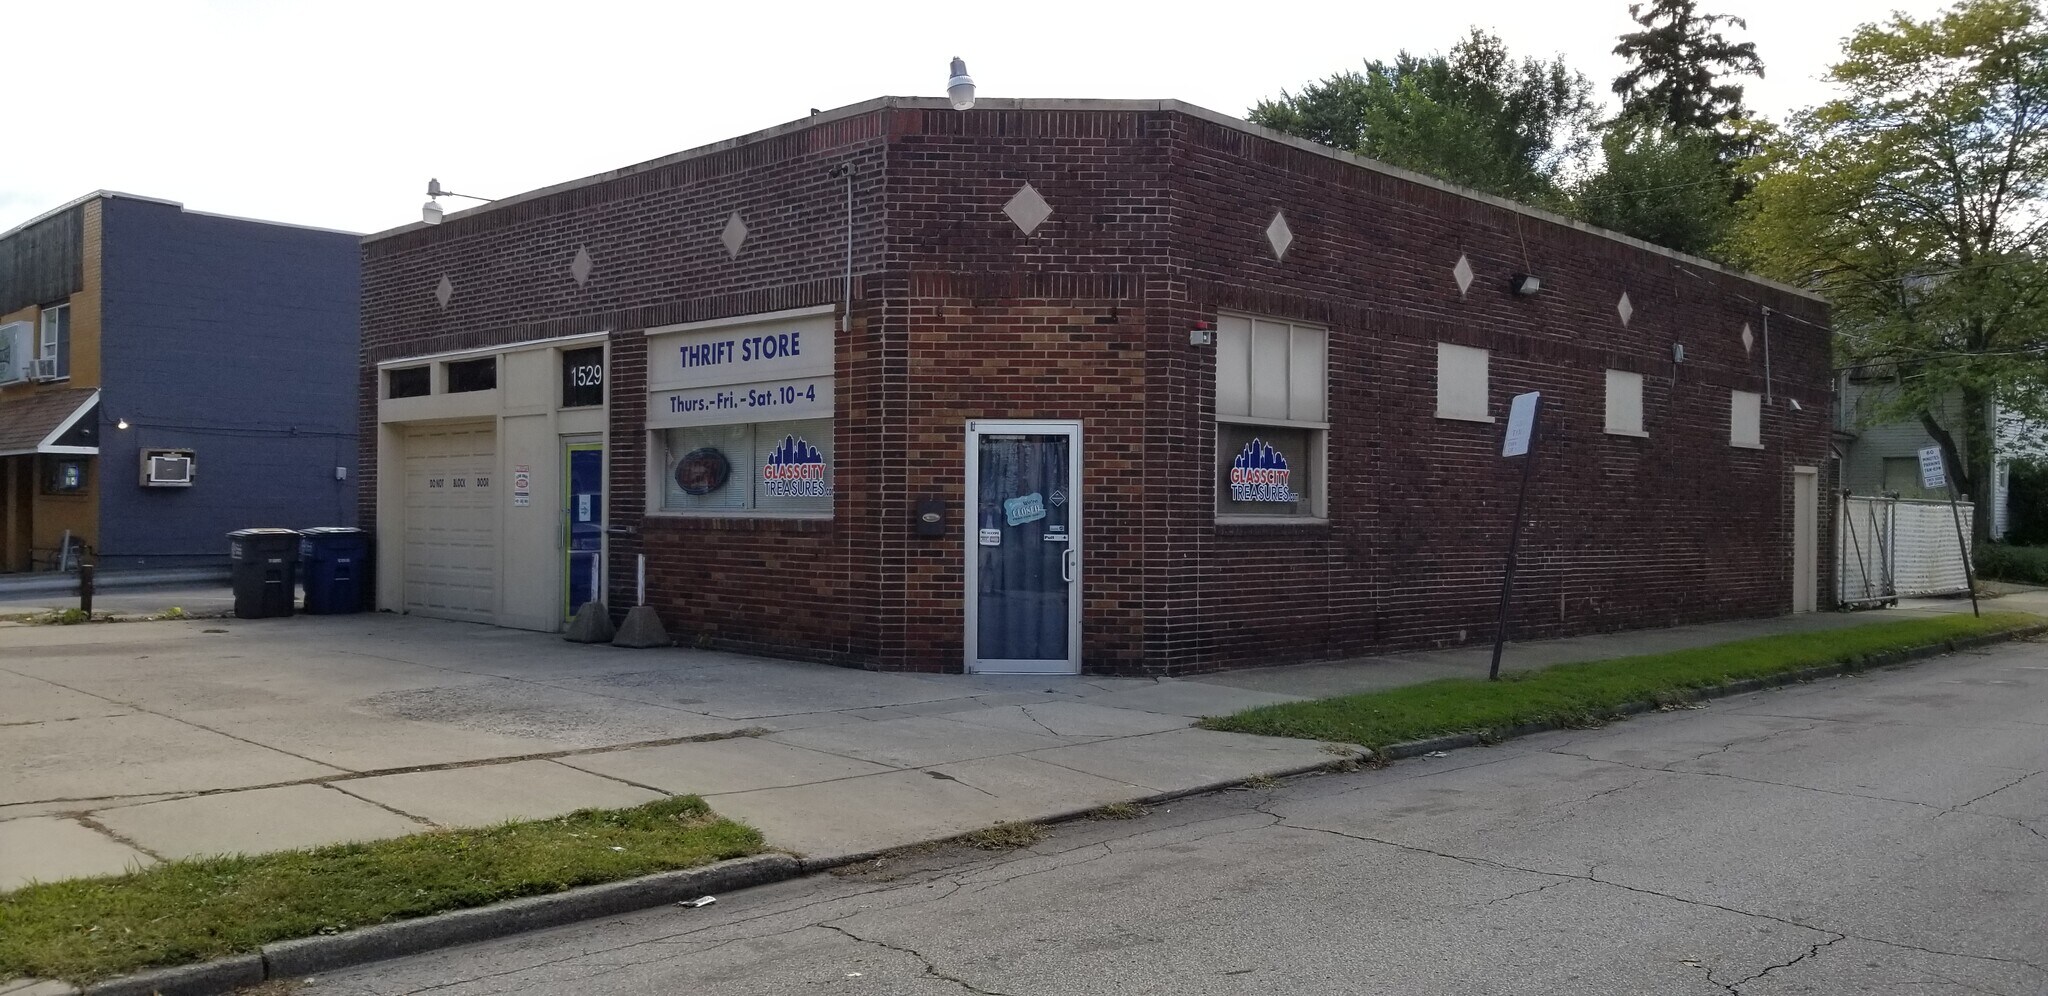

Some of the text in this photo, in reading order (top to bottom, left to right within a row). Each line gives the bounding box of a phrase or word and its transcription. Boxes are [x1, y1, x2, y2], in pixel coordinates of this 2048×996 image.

[680, 332, 800, 368] THRIFT STORE
[571, 364, 602, 387] 1529
[763, 463, 826, 480] GLASSCITY
[1231, 467, 1290, 485] GLASSCITY
[453, 478, 467, 488] BLOCK
[476, 478, 489, 487] DOOR
